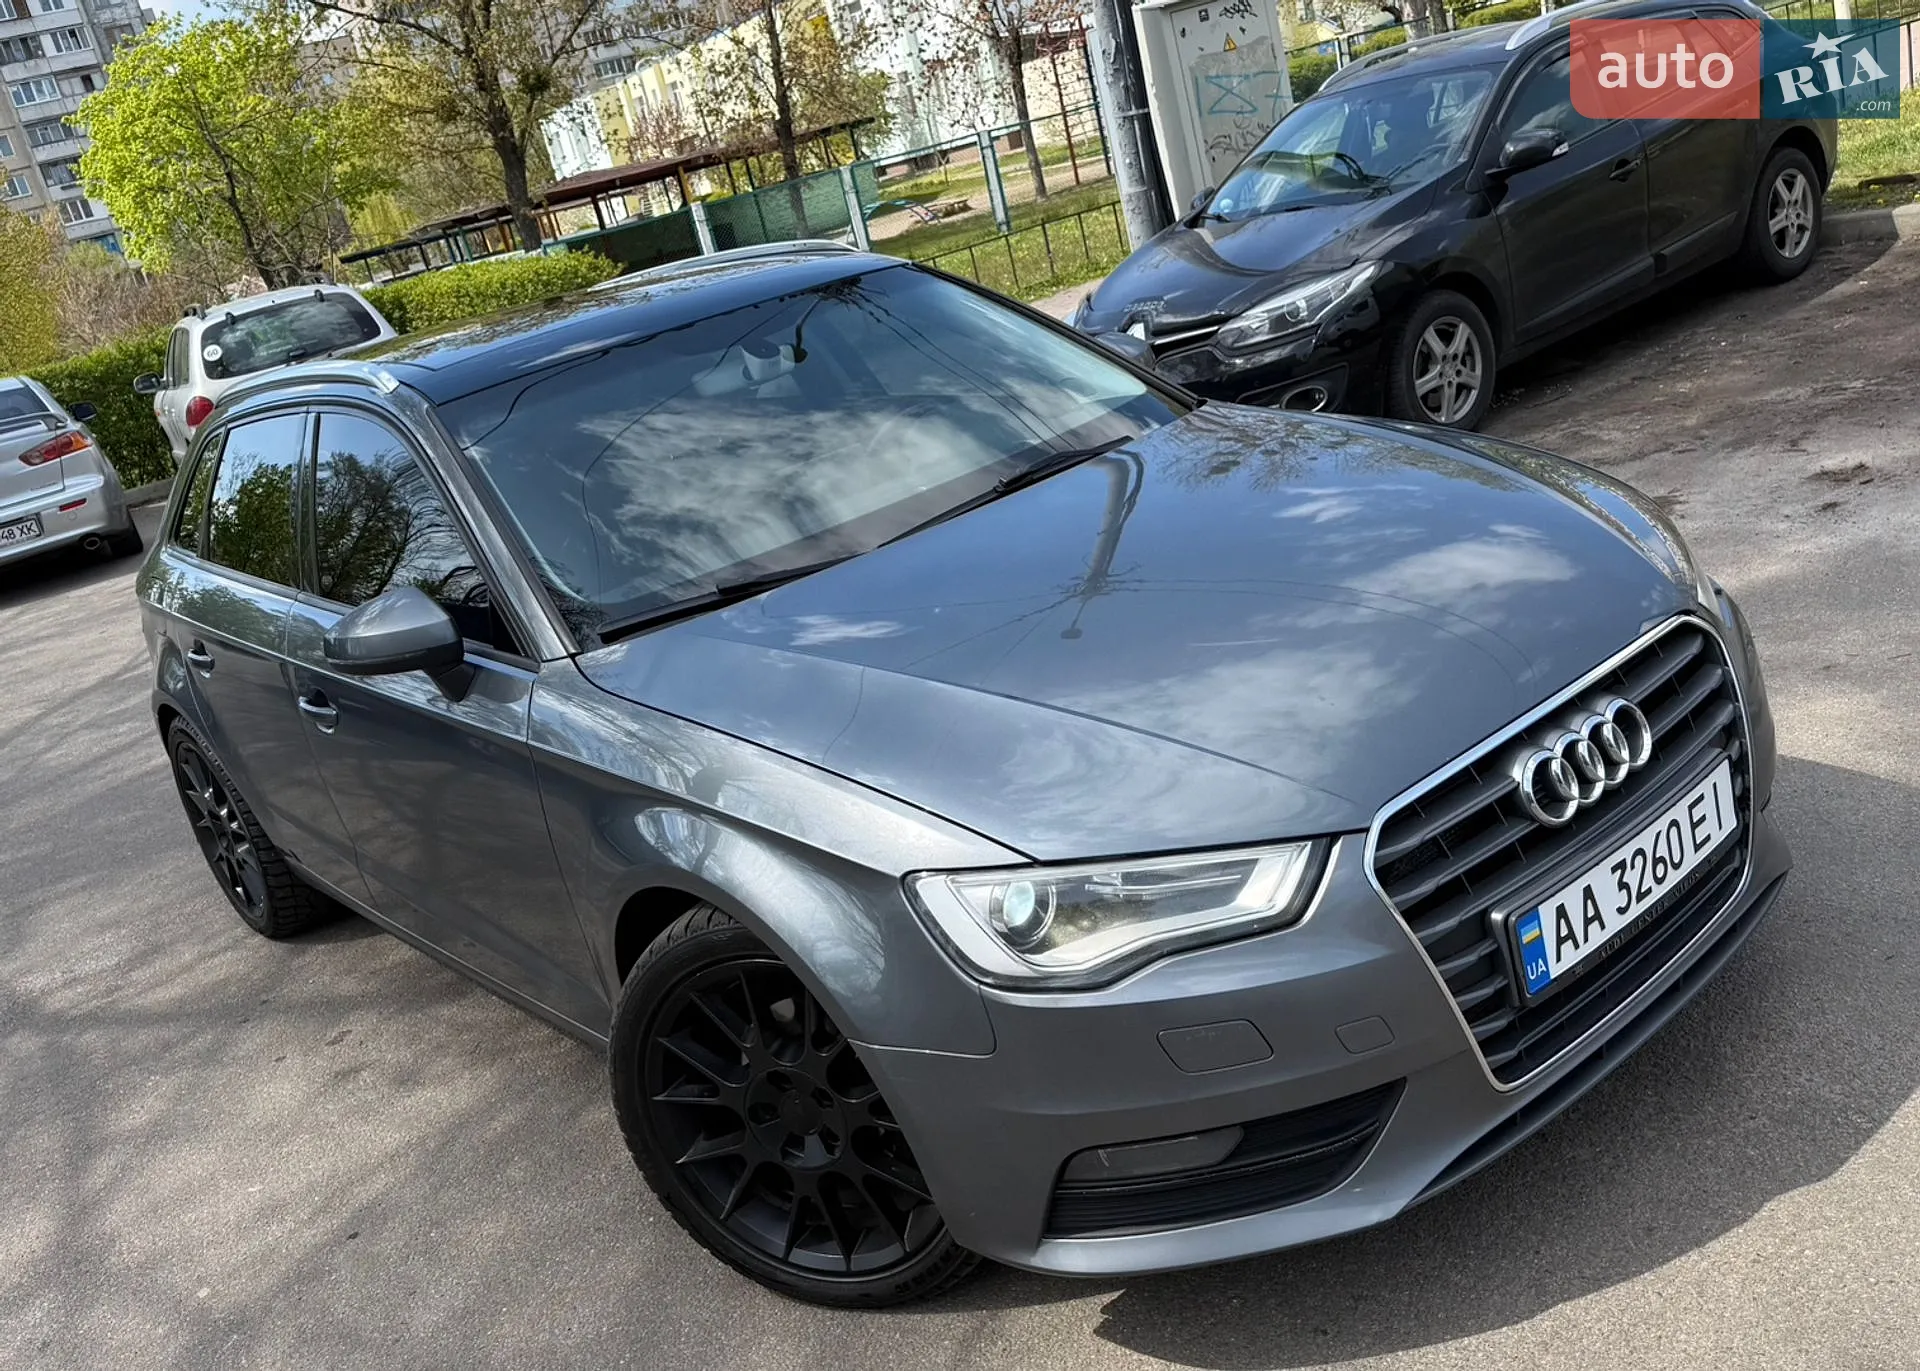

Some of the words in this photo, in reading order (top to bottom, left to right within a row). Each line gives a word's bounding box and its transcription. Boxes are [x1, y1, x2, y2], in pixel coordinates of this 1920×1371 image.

[18, 522, 37, 537] XK
[1555, 884, 1606, 963] AA
[1610, 818, 1684, 914] 3260
[1687, 782, 1722, 854] EI
[1527, 962, 1548, 980] UA
